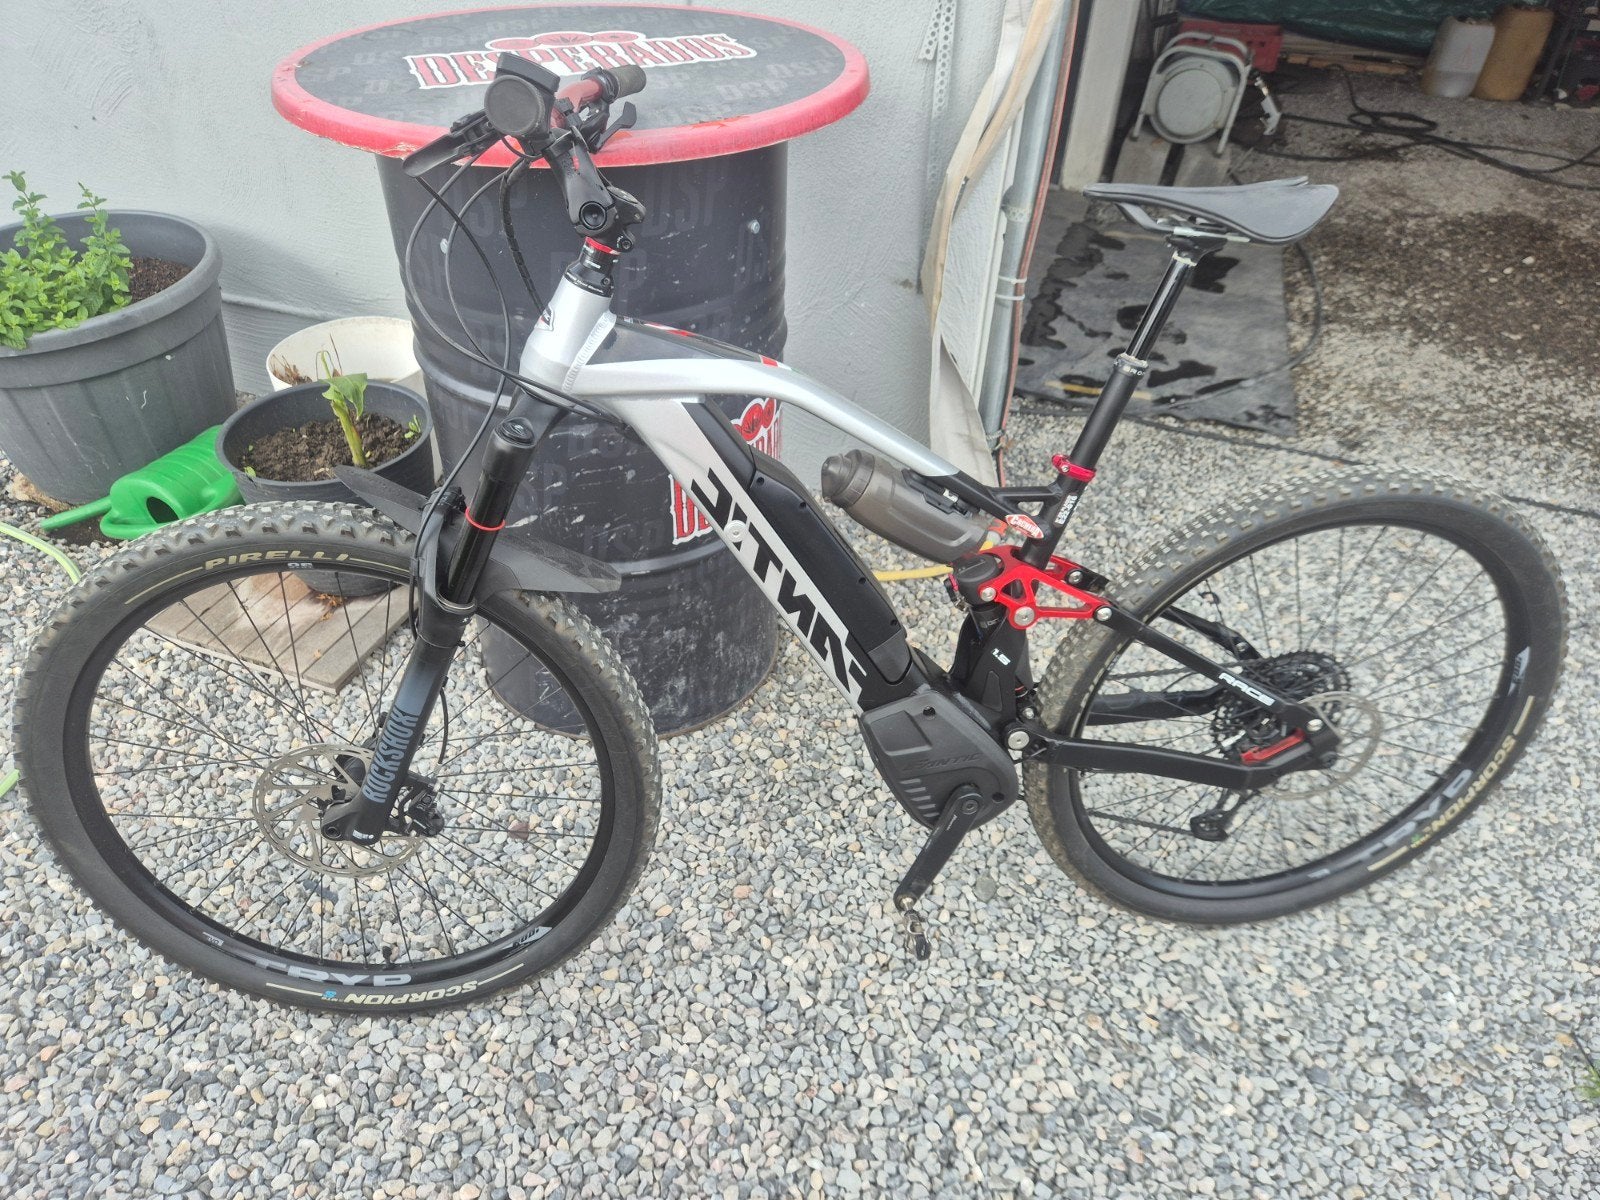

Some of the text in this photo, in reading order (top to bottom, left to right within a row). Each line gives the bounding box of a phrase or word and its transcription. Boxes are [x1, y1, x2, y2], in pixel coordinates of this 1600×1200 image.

[405, 33, 755, 88] DEPERADOS
[205, 550, 349, 570] PIRELLI
[362, 704, 420, 804] ROCKSHOX
[1432, 733, 1517, 832] SCORPION
[343, 980, 478, 1005] SCORPION
